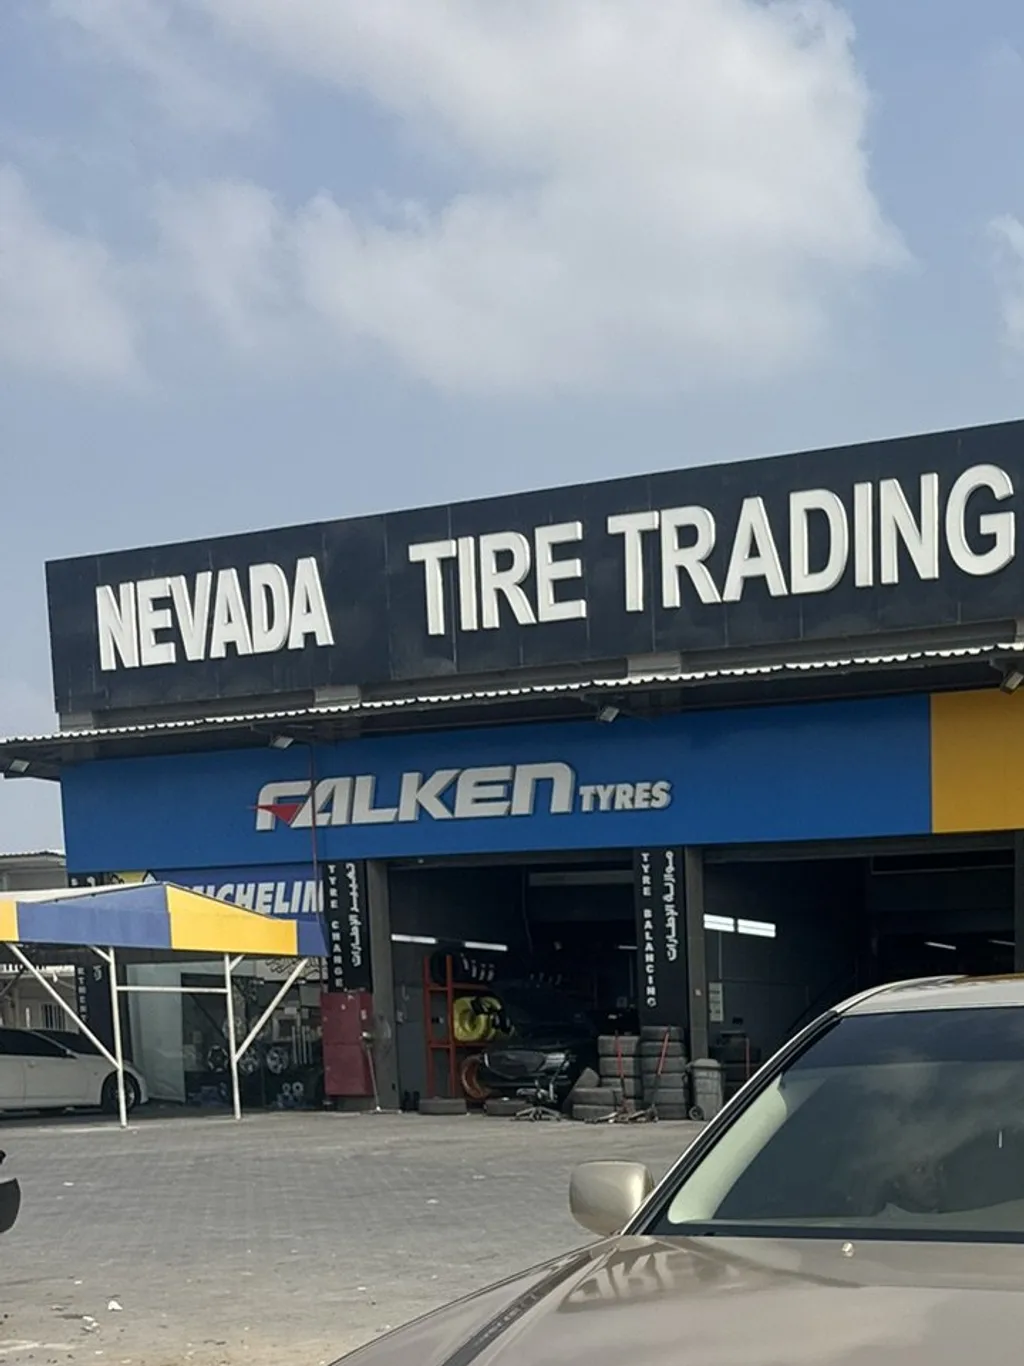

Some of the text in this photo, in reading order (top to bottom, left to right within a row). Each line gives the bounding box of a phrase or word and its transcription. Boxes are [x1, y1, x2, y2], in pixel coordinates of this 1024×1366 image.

[96, 463, 1015, 671] NEVADA TIRE TRADING
[254, 761, 672, 831] FALKEN TYRES
[181, 879, 324, 914] CHELIN
[327, 864, 343, 987] TYRE CHANGE
[640, 852, 657, 1008] TYRE BALANCING
